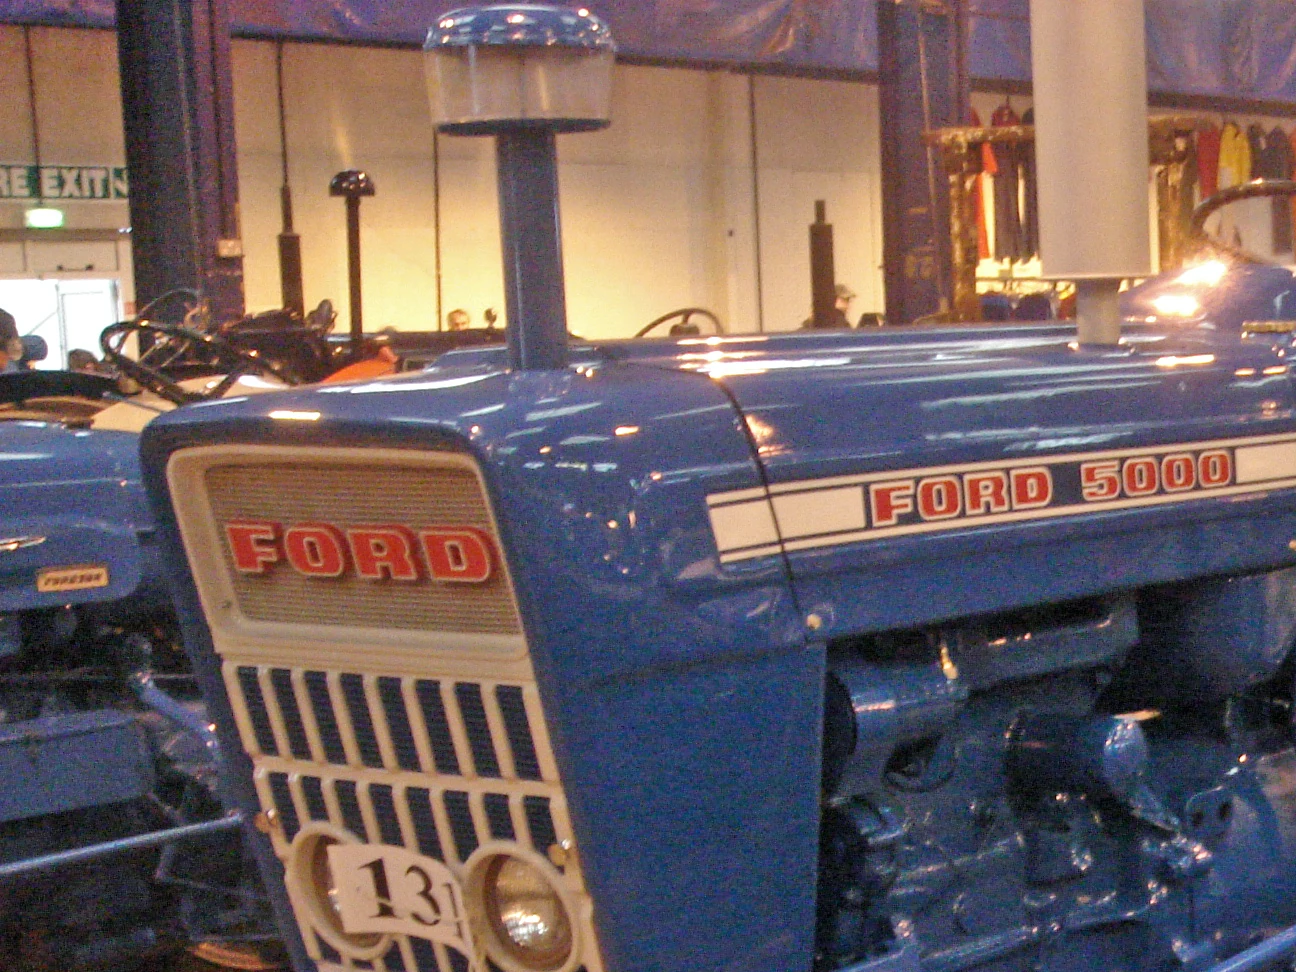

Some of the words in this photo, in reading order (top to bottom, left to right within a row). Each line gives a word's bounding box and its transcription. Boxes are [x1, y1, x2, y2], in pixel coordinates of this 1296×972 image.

[41, 167, 110, 198] EXIT
[869, 467, 1053, 528] FORD
[1081, 449, 1232, 501] 5000
[225, 521, 493, 583] FORD
